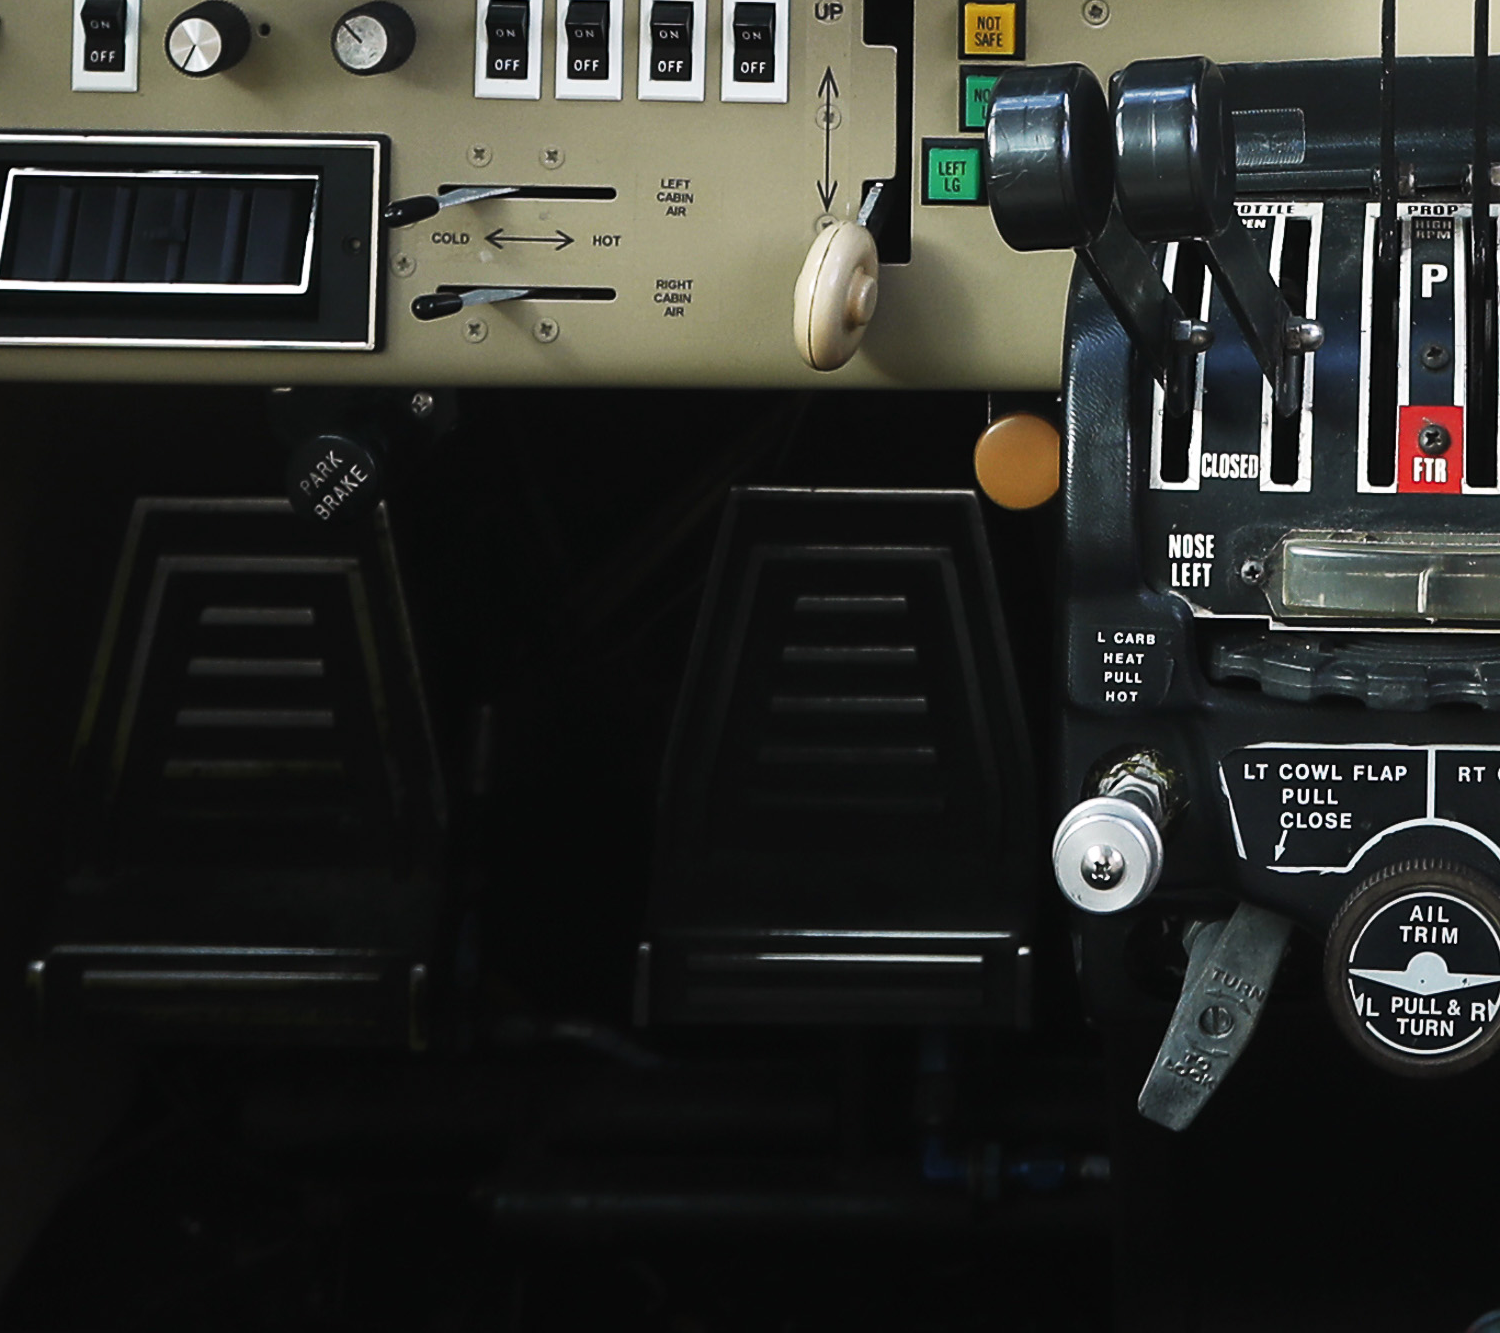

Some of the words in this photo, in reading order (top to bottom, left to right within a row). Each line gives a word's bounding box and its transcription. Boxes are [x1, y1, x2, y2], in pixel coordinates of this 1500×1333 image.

[816, 2, 842, 20] UP
[977, 17, 1001, 31] NOT
[975, 33, 1003, 47] SAFE
[495, 58, 520, 70] OFF
[1408, 204, 1459, 215] PROP
[432, 233, 470, 244] COLD
[592, 236, 621, 247] HOT
[298, 450, 346, 496] PARK
[1202, 453, 1259, 478] CLOSED
[1413, 458, 1446, 483] FTR
[313, 464, 371, 522] BRAKE
[1168, 536, 1214, 560] NOSE
[1171, 561, 1212, 587] LEFT
[1098, 632, 1106, 644] L
[1115, 633, 1155, 645] CARB
[1104, 653, 1145, 665] HEAT
[1105, 671, 1142, 684] PULL
[1105, 691, 1138, 703] HOT
[1244, 765, 1268, 781] LT
[1279, 765, 1345, 782] COWL
[1354, 765, 1407, 782] FLAP
[1457, 767, 1485, 783] RT
[1282, 788, 1338, 806] PULL
[1280, 812, 1352, 830] CLOSE
[1410, 906, 1448, 923] AIL
[1399, 926, 1459, 945] TRIM
